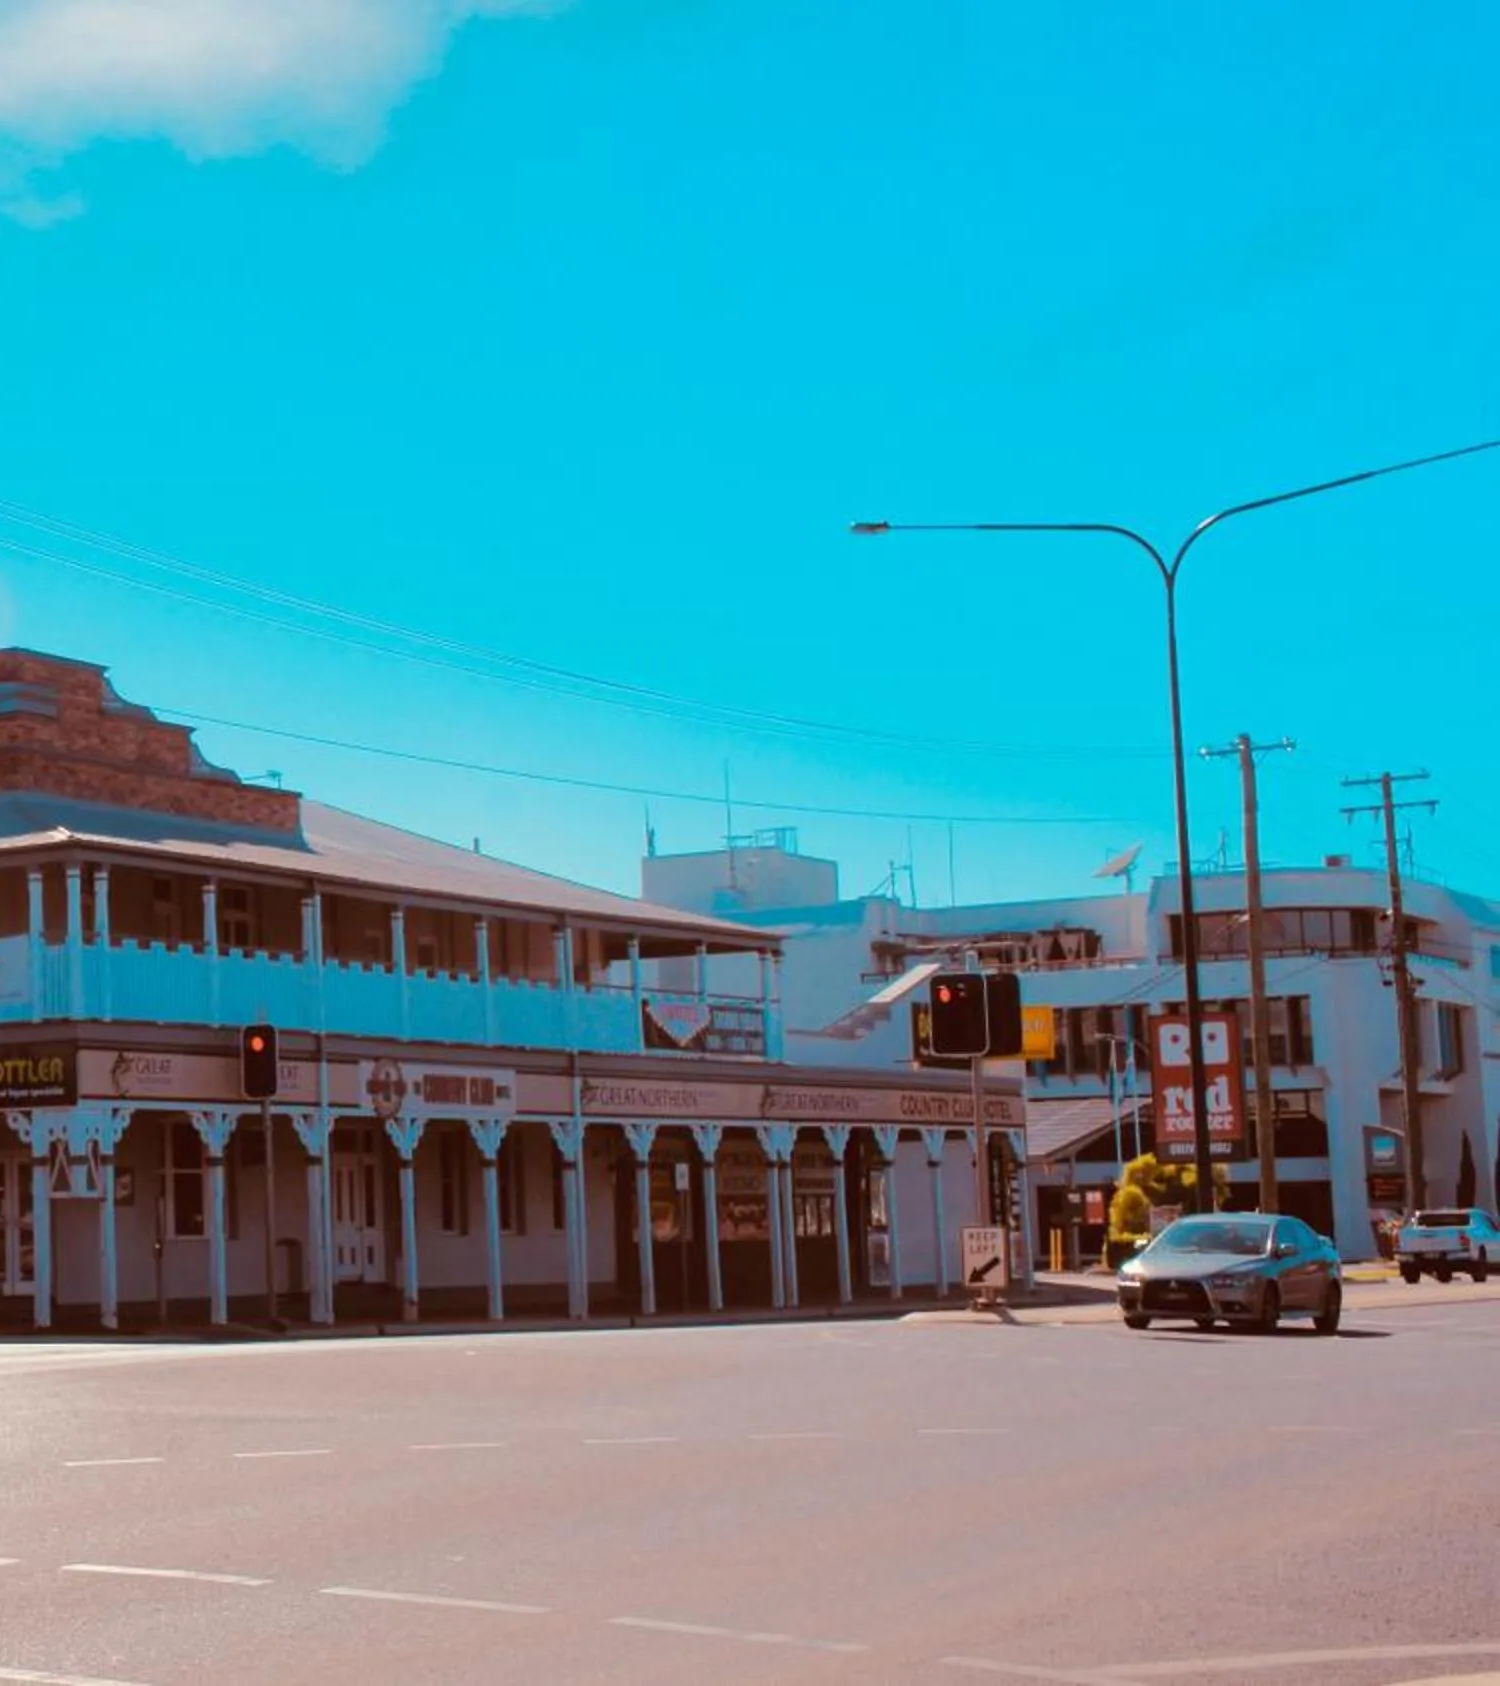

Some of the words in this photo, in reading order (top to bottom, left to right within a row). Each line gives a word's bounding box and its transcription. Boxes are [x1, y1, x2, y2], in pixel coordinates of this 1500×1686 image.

[900, 1094, 949, 1118] COUNTRY
[968, 1231, 997, 1241] KEEP
[969, 1243, 997, 1255] LEFT
